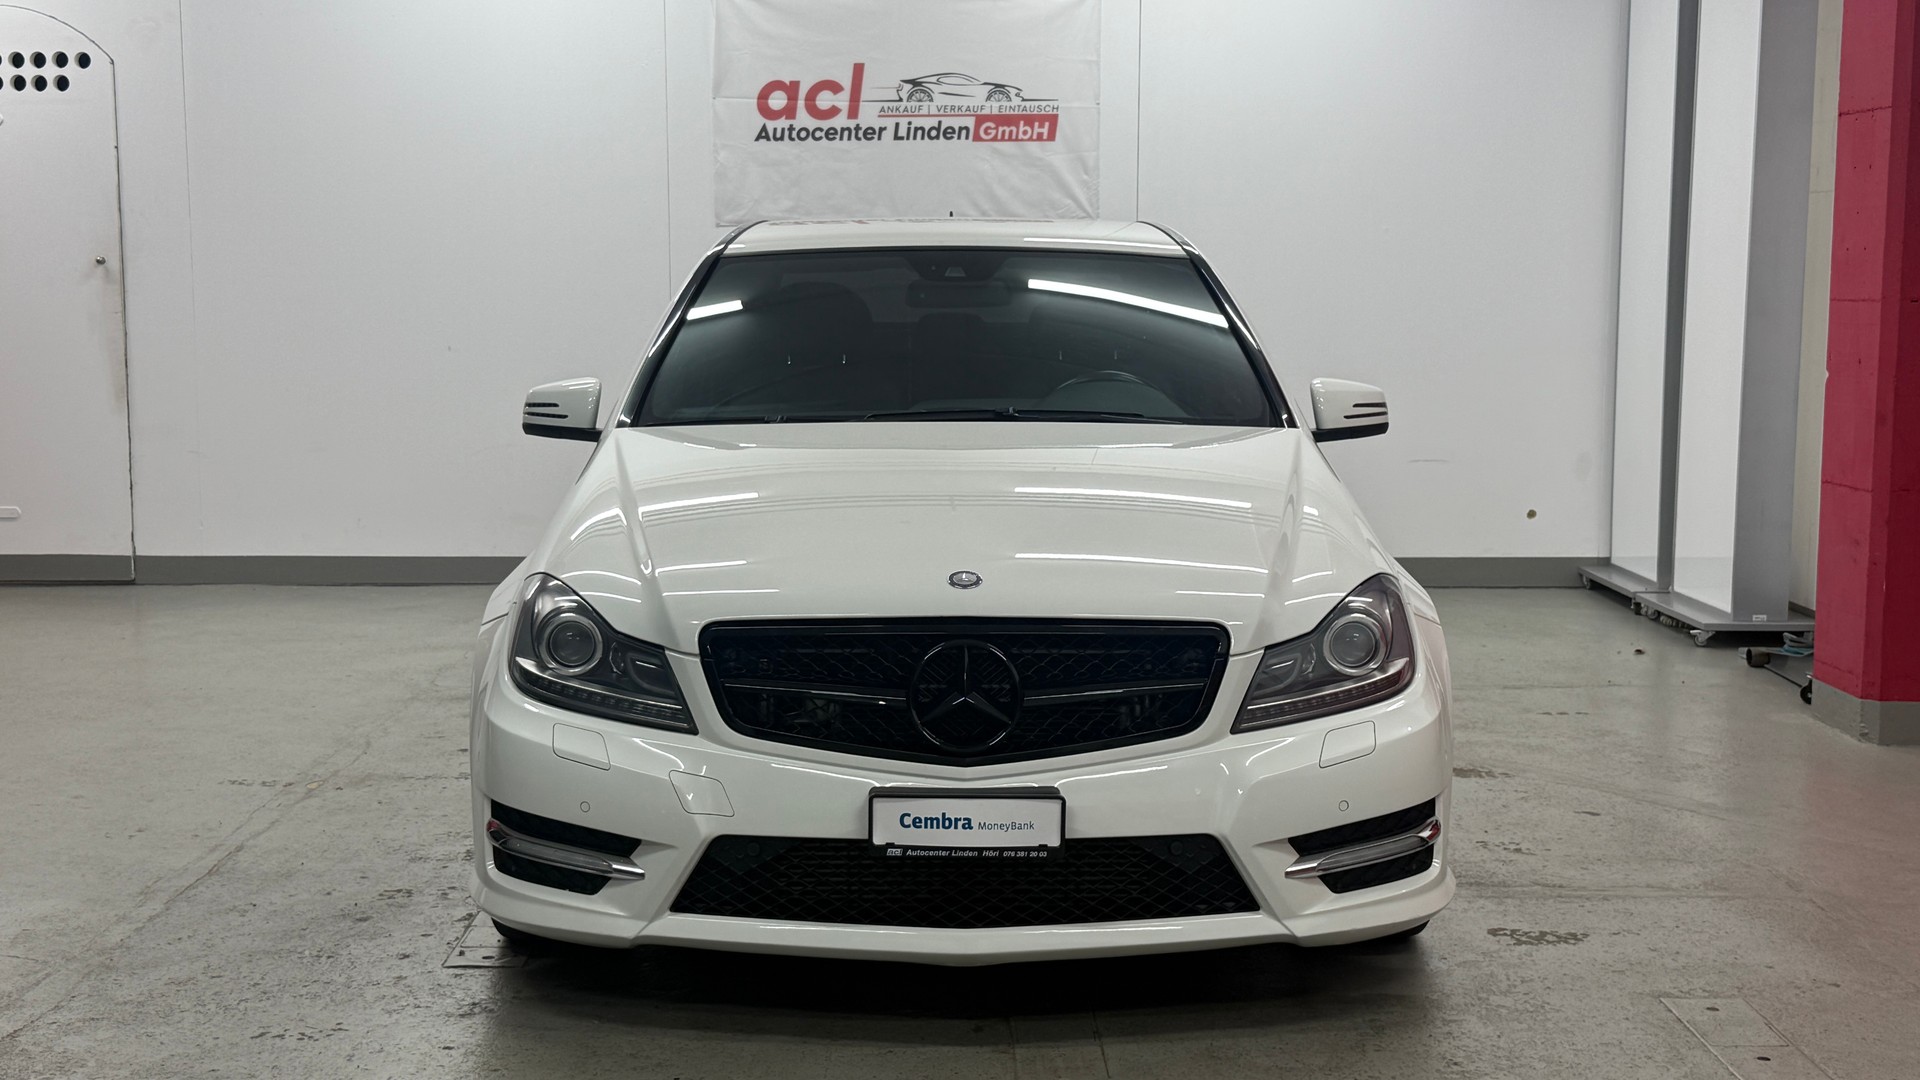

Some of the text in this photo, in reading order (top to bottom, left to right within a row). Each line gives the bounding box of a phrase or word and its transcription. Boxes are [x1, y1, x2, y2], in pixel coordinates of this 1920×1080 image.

[756, 62, 865, 121] acl
[879, 104, 1060, 114] ANKAUF VERKAUF EINTAUSCH
[754, 120, 1050, 143] Autocenter Linden GmbH
[899, 812, 1035, 832] Cembra MoneyBank
[906, 849, 950, 857] Autocenter
[951, 849, 978, 857] Linden
